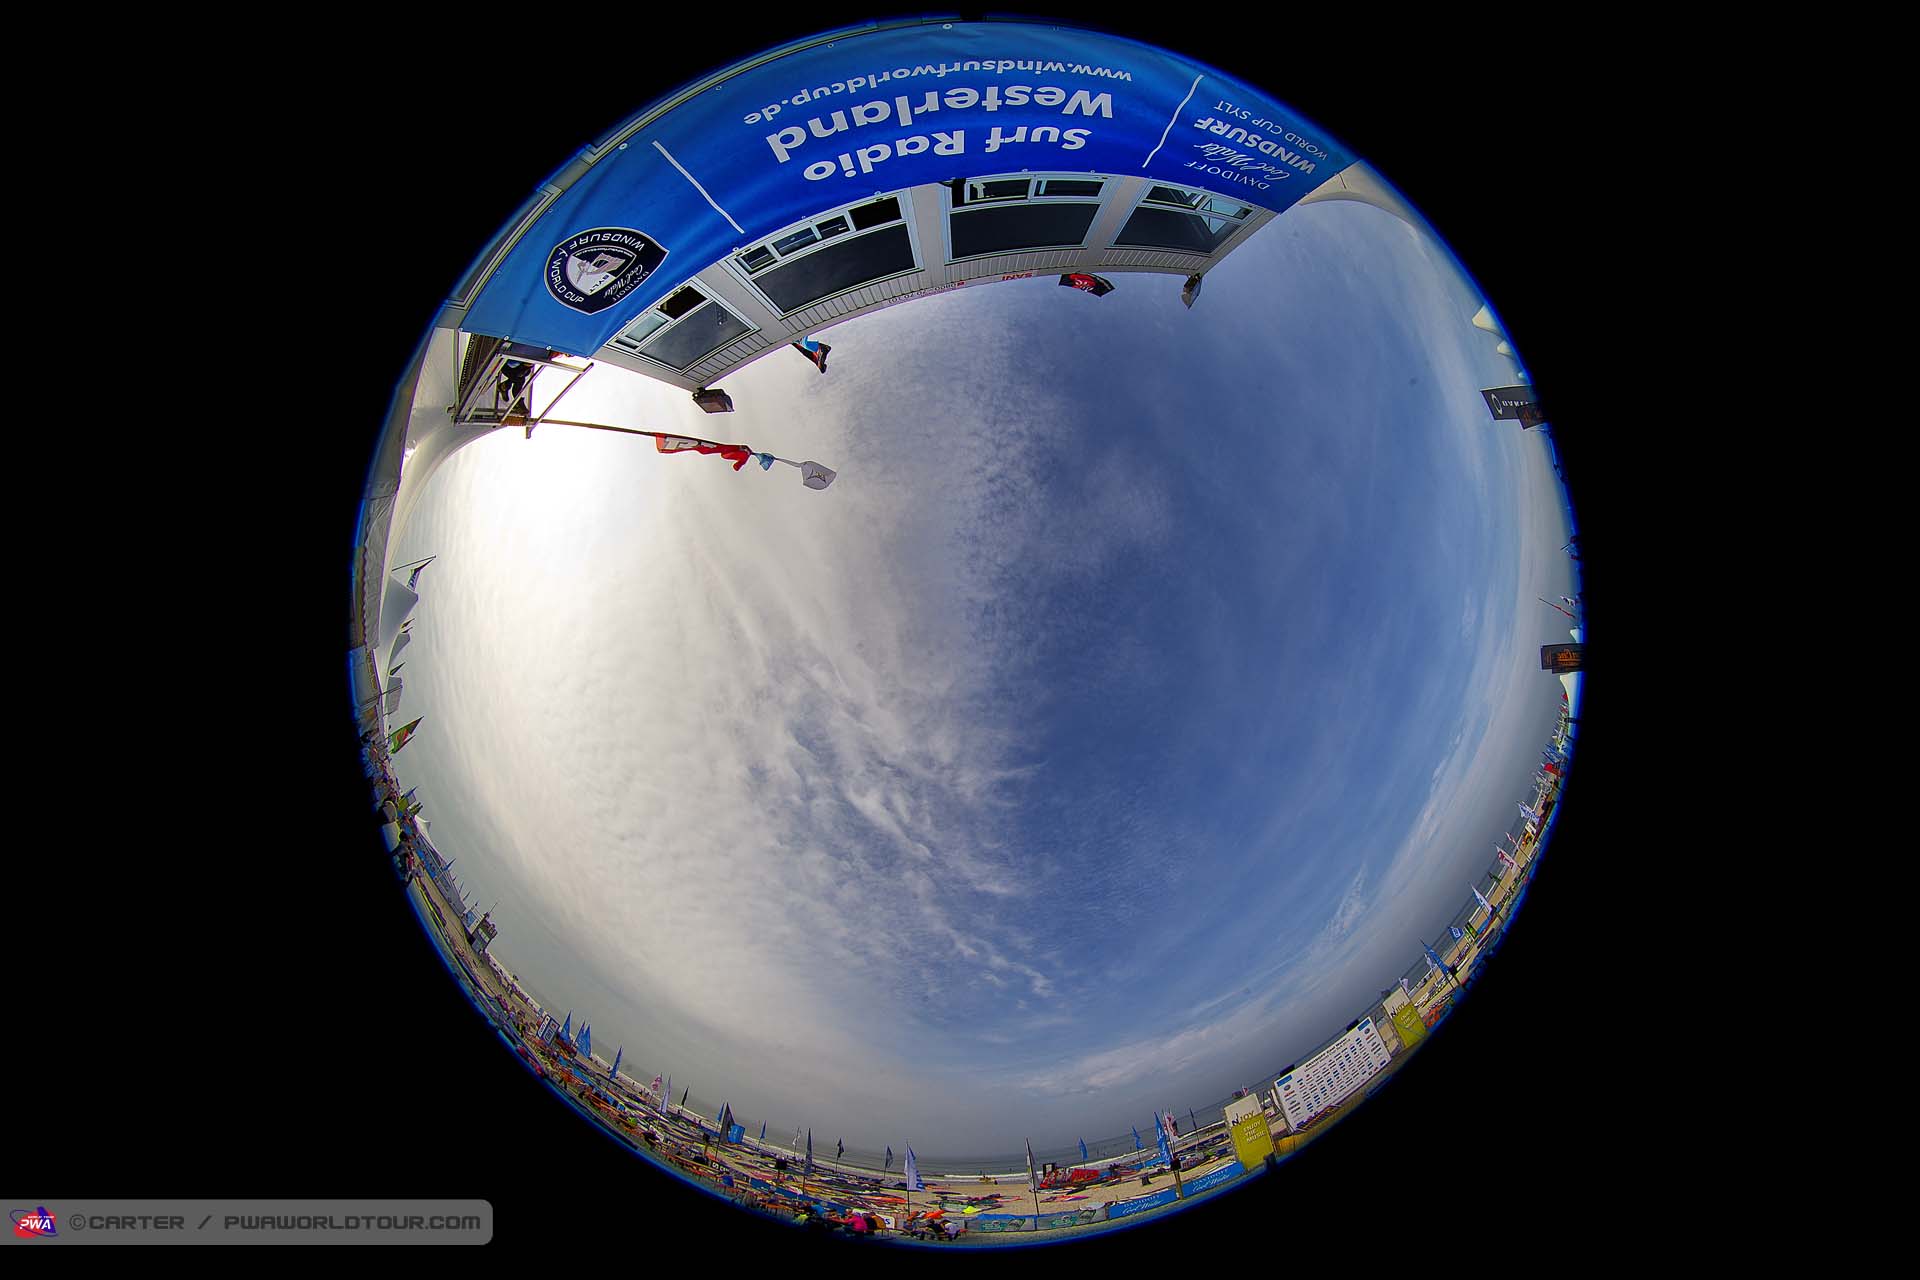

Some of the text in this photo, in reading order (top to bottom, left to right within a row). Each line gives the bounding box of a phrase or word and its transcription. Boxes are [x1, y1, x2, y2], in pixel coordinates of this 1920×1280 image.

[743, 60, 1132, 124] www.windsurfworldcup.de
[765, 85, 1113, 163] Westerland
[1194, 116, 1317, 175] WINDSURF
[1213, 100, 1328, 160] WORLD CUP SYLT
[803, 126, 1092, 181] Surf Radio
[1183, 160, 1271, 191] DAVIDOFF
[1193, 142, 1290, 181] Cool Water
[569, 233, 645, 252] WINDSURF
[551, 257, 585, 303] WORLD CUP
